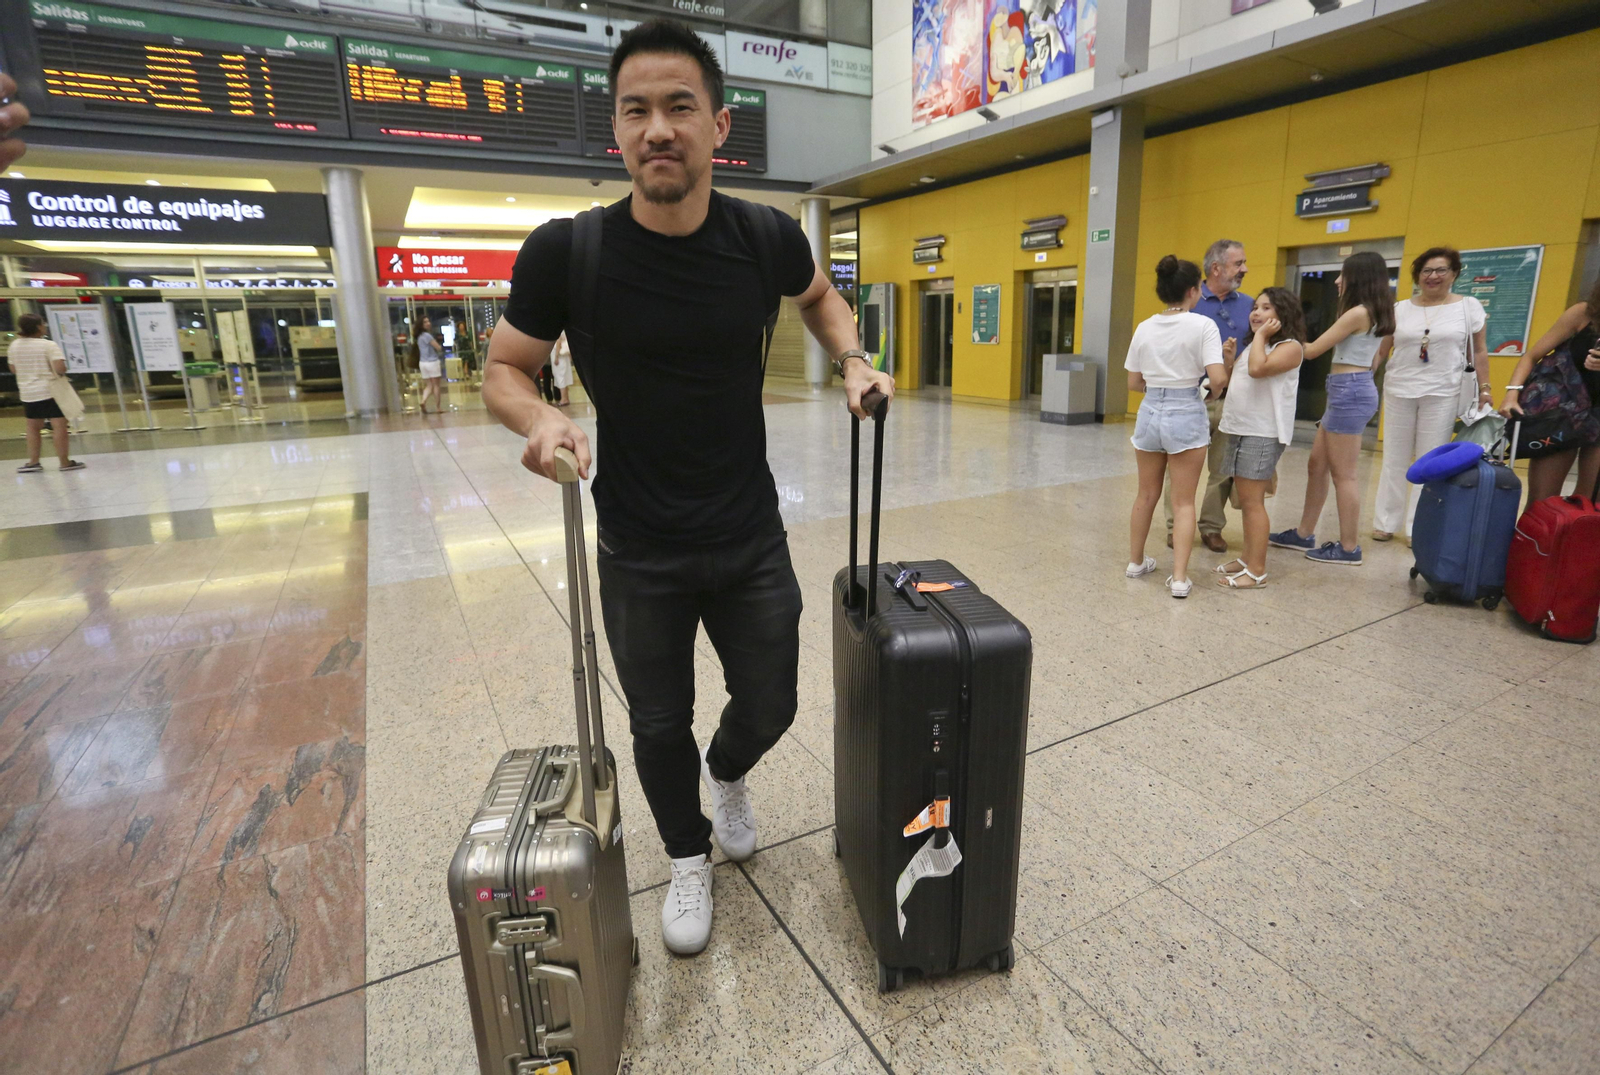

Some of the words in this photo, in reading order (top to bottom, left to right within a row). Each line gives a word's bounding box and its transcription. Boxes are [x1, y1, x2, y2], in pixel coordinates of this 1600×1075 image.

[32, 1, 90, 21] Salidas
[300, 39, 328, 50] adif
[347, 43, 389, 58] Salidas
[742, 40, 797, 63] renfe
[547, 68, 570, 79] adif
[784, 65, 814, 80] AVE
[1313, 193, 1357, 204] Aparcamiento
[28, 191, 118, 213] Control
[122, 196, 154, 215] de
[159, 198, 265, 222] equipajes
[32, 214, 111, 229] LUGGAGE
[112, 217, 182, 231] CONTROL
[412, 253, 429, 264] No
[431, 255, 465, 267] pasar
